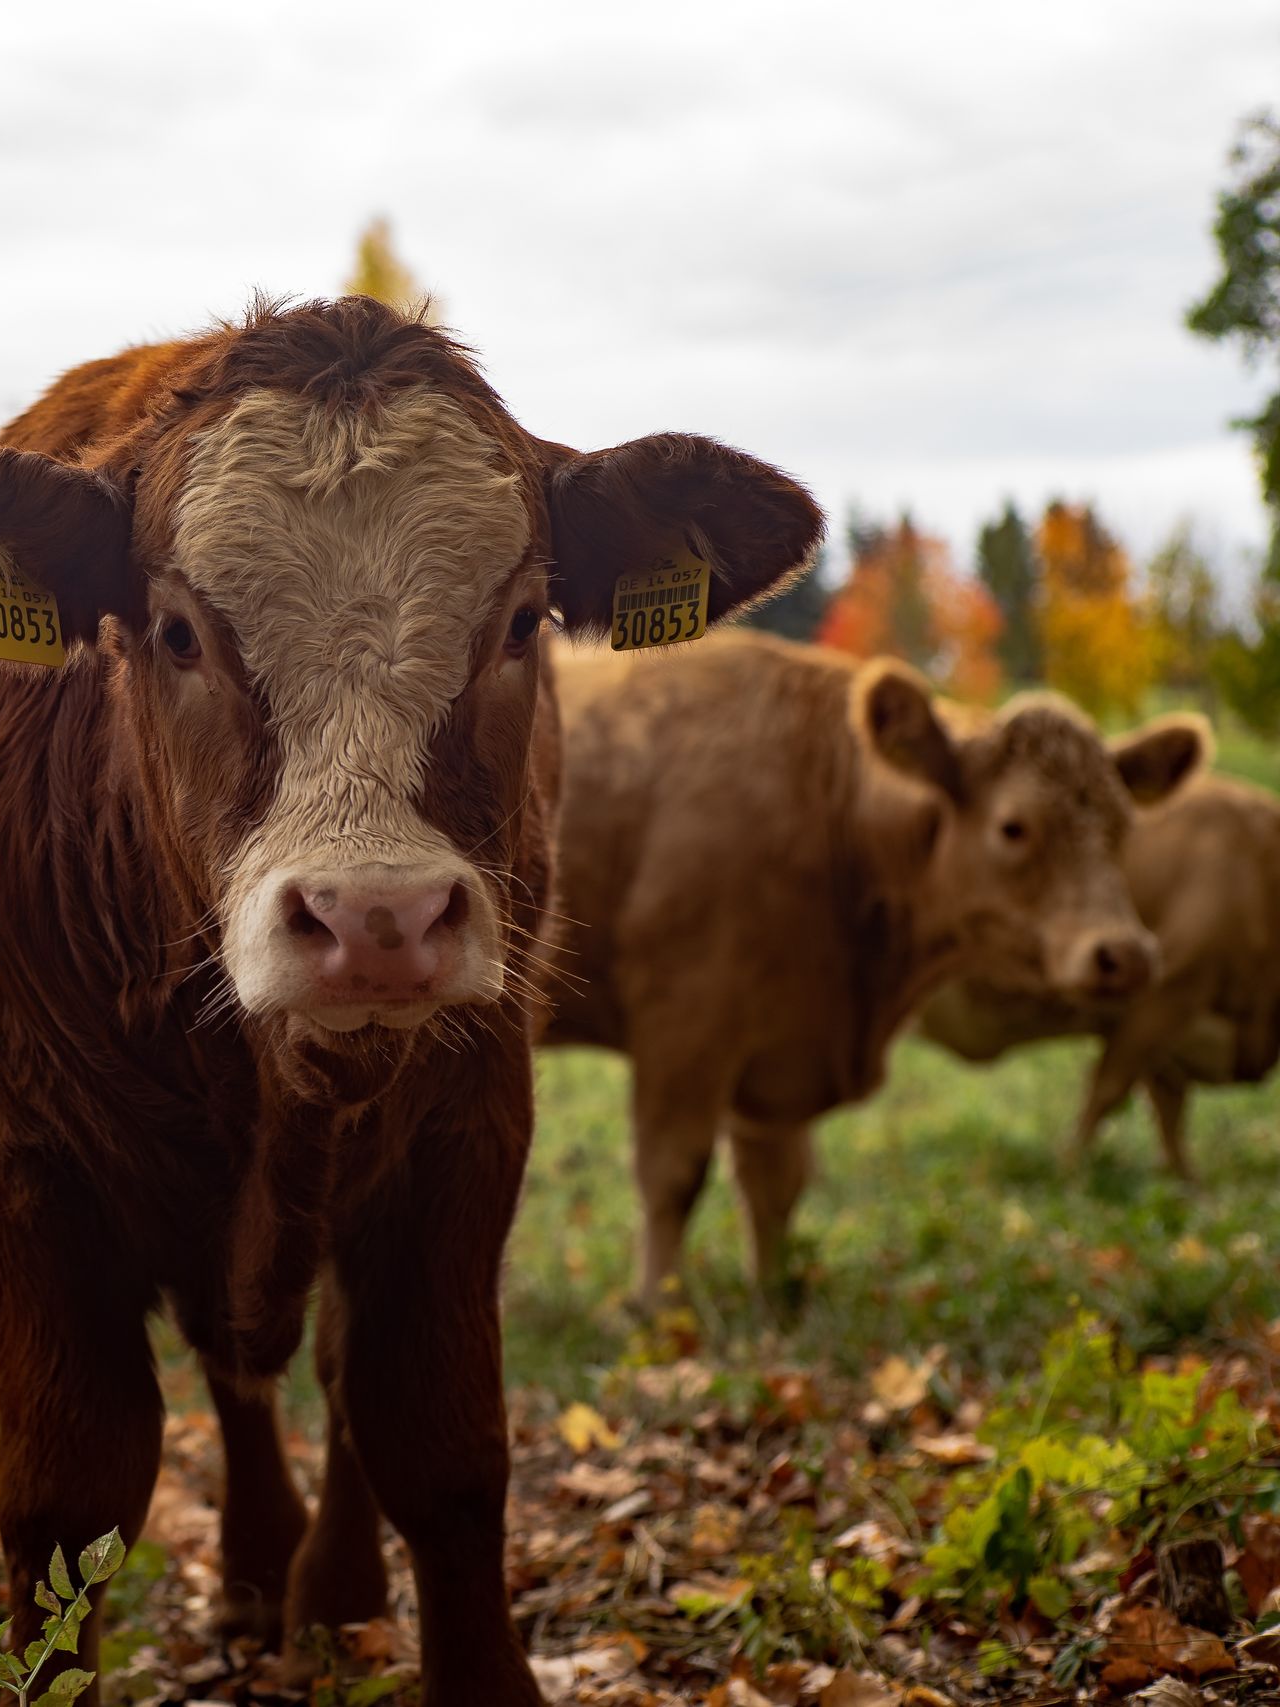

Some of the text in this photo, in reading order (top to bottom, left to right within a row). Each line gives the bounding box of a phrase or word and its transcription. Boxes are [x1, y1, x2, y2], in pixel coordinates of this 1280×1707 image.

[618, 578, 639, 592] DE
[671, 568, 703, 584] 057
[22, 591, 51, 605] 057
[613, 600, 701, 650] 30853
